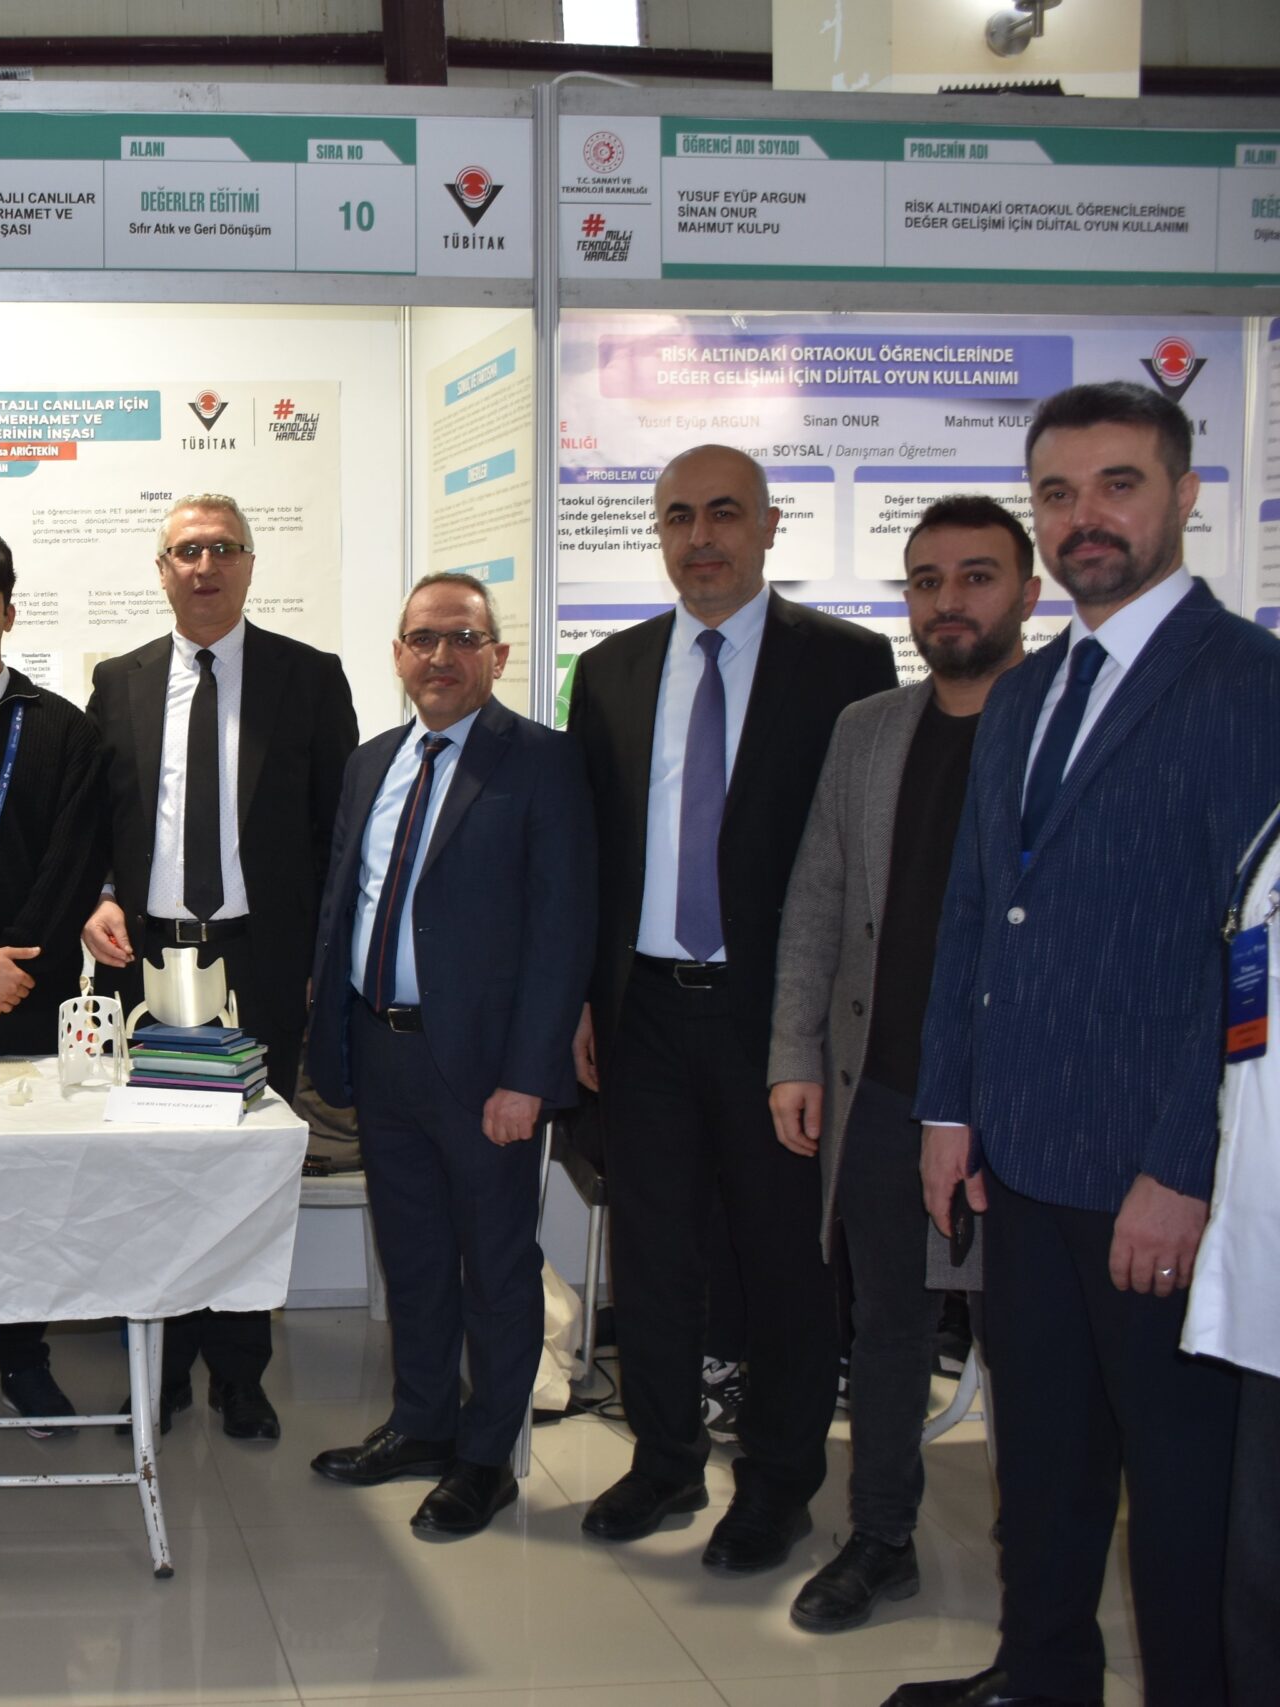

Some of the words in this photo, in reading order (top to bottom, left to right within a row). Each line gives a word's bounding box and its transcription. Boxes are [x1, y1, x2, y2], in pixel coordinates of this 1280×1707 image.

[130, 142, 164, 156] ALANI
[682, 134, 732, 153] ÖĞRENCİ
[735, 139, 755, 154] ADI
[758, 140, 799, 155] SOYADI
[910, 136, 966, 158] PROJENİN
[969, 137, 988, 159] ADI
[316, 145, 343, 159] SIRA
[347, 145, 363, 160] NO
[1244, 150, 1276, 164] ALANI
[27, 193, 95, 204] CANLILAR
[141, 187, 205, 212] DEĞERLER
[209, 187, 259, 212] EĞİTİMİ
[677, 191, 719, 204] YUSUF
[723, 190, 757, 203] EYÜP
[760, 192, 806, 204] ARGUN
[55, 208, 72, 219] VE
[678, 204, 716, 217] SİNAN
[720, 207, 756, 218] ONUR
[905, 200, 933, 216] RİSK
[936, 202, 1002, 214] ALTINDAKİ
[1005, 204, 1072, 216] ORTAOKUL
[1076, 203, 1185, 217] ÖĞRENCİLERİNDE
[339, 201, 374, 231] 10
[129, 223, 151, 234] Sıfır
[153, 223, 175, 234] Atık
[178, 226, 191, 234] ve
[193, 223, 216, 235] Geri
[219, 224, 271, 237] Dönüşüm
[678, 222, 733, 233] MAHMUT
[737, 223, 779, 234] KULPU
[904, 215, 948, 228] DEĞER
[951, 217, 1005, 231] GELİŞİMİ
[1008, 217, 1032, 232] İÇİN
[1036, 218, 1080, 231] DİJİTAL
[1083, 220, 1119, 231] OYUN
[1122, 221, 1189, 232] KULLANIMI
[443, 233, 504, 249] TÜBİTAK
[661, 346, 698, 363] RİSK
[701, 345, 786, 363] ALTINDAKİ
[790, 347, 876, 362] ORTAOKUL
[879, 345, 1013, 362] ÖĞRENCİLERİNDE
[657, 368, 710, 385] DEĞER
[714, 368, 784, 387] GELİŞİMİ
[788, 367, 821, 386] İÇİN
[825, 367, 881, 383] DİJİTAL
[884, 370, 929, 384] OYUN
[933, 371, 1018, 384] KULLANIMI
[42, 400, 114, 410] CANLILAR
[119, 397, 148, 412] İÇİN
[83, 414, 101, 424] VE
[803, 415, 837, 426] Sinan
[841, 415, 879, 427] ONUR
[944, 416, 994, 427] Mahmut
[47, 427, 94, 441] İNŞASI
[182, 436, 235, 450] TÜBİTAK
[9, 445, 58, 456] ARIĞTEKİN
[772, 445, 824, 457] SOYSAL
[827, 445, 832, 457] /
[835, 445, 894, 459] Danışman
[898, 443, 957, 459] Öğretmen
[140, 492, 172, 501] Hipotez
[590, 511, 646, 523] geleneksel
[574, 526, 628, 537] etkileşimli
[870, 525, 901, 533] adalet
[577, 541, 620, 552] duyulan
